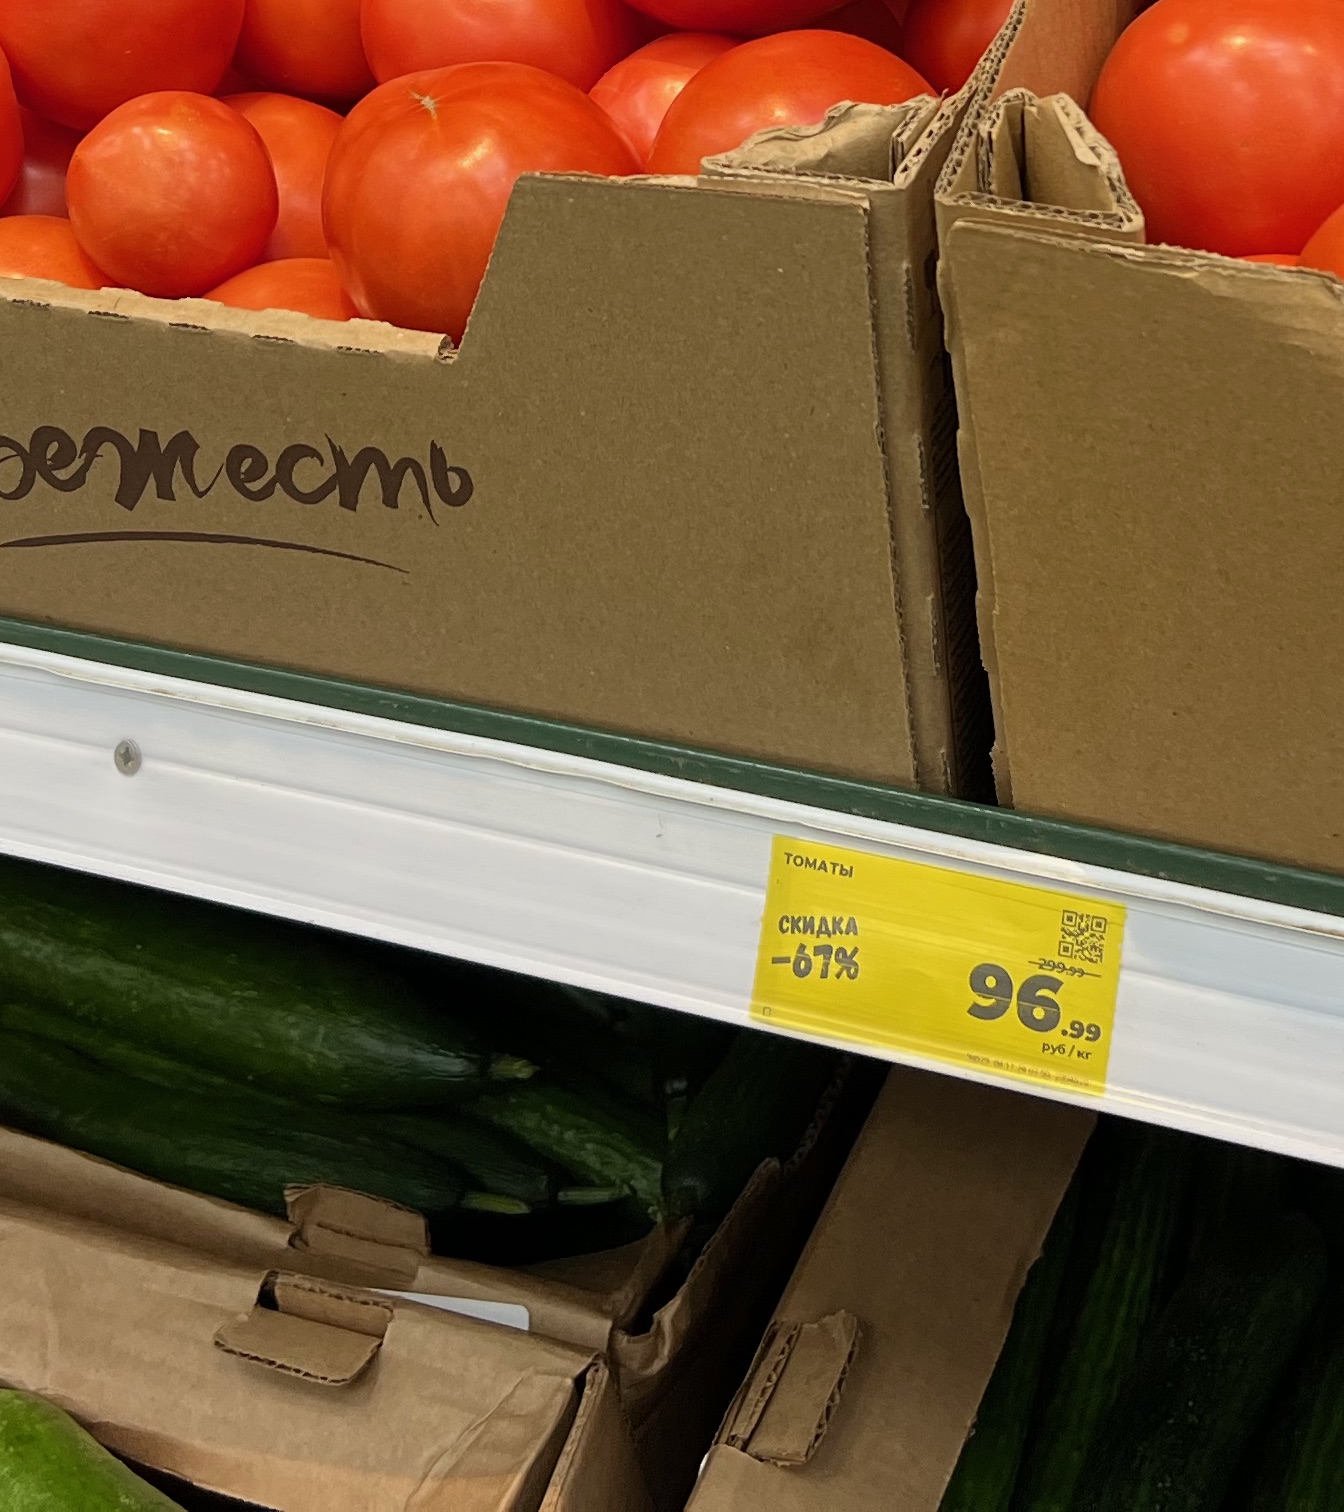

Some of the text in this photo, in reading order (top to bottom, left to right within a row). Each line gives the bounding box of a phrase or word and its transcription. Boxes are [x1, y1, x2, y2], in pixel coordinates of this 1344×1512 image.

[783, 852, 854, 878] ТОМАТЫ
[778, 914, 859, 939] СКИДКА
[771, 943, 861, 981] -67%
[967, 962, 1102, 1042] 96.99
